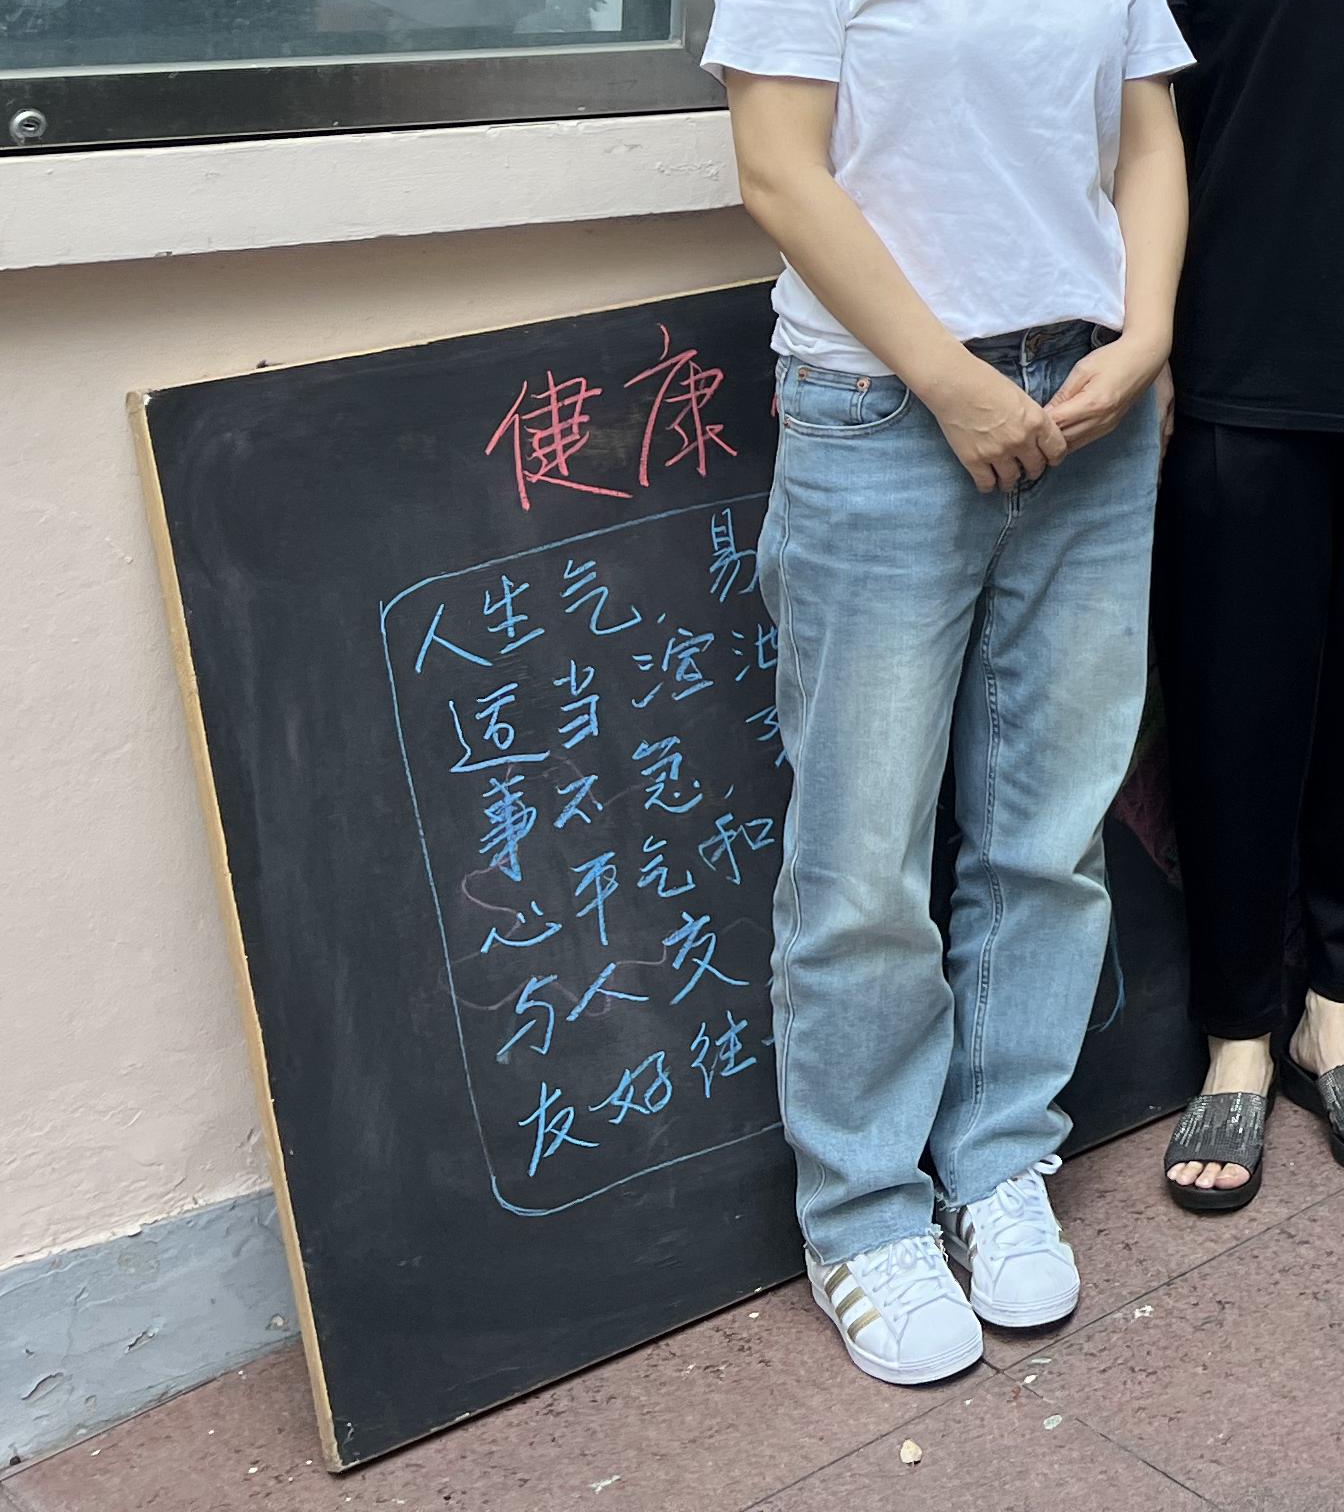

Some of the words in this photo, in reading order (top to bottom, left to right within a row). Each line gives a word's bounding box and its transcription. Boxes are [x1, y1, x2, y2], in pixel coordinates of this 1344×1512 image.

[485, 323, 738, 511] 健康
[480, 813, 775, 954] 心平气和
